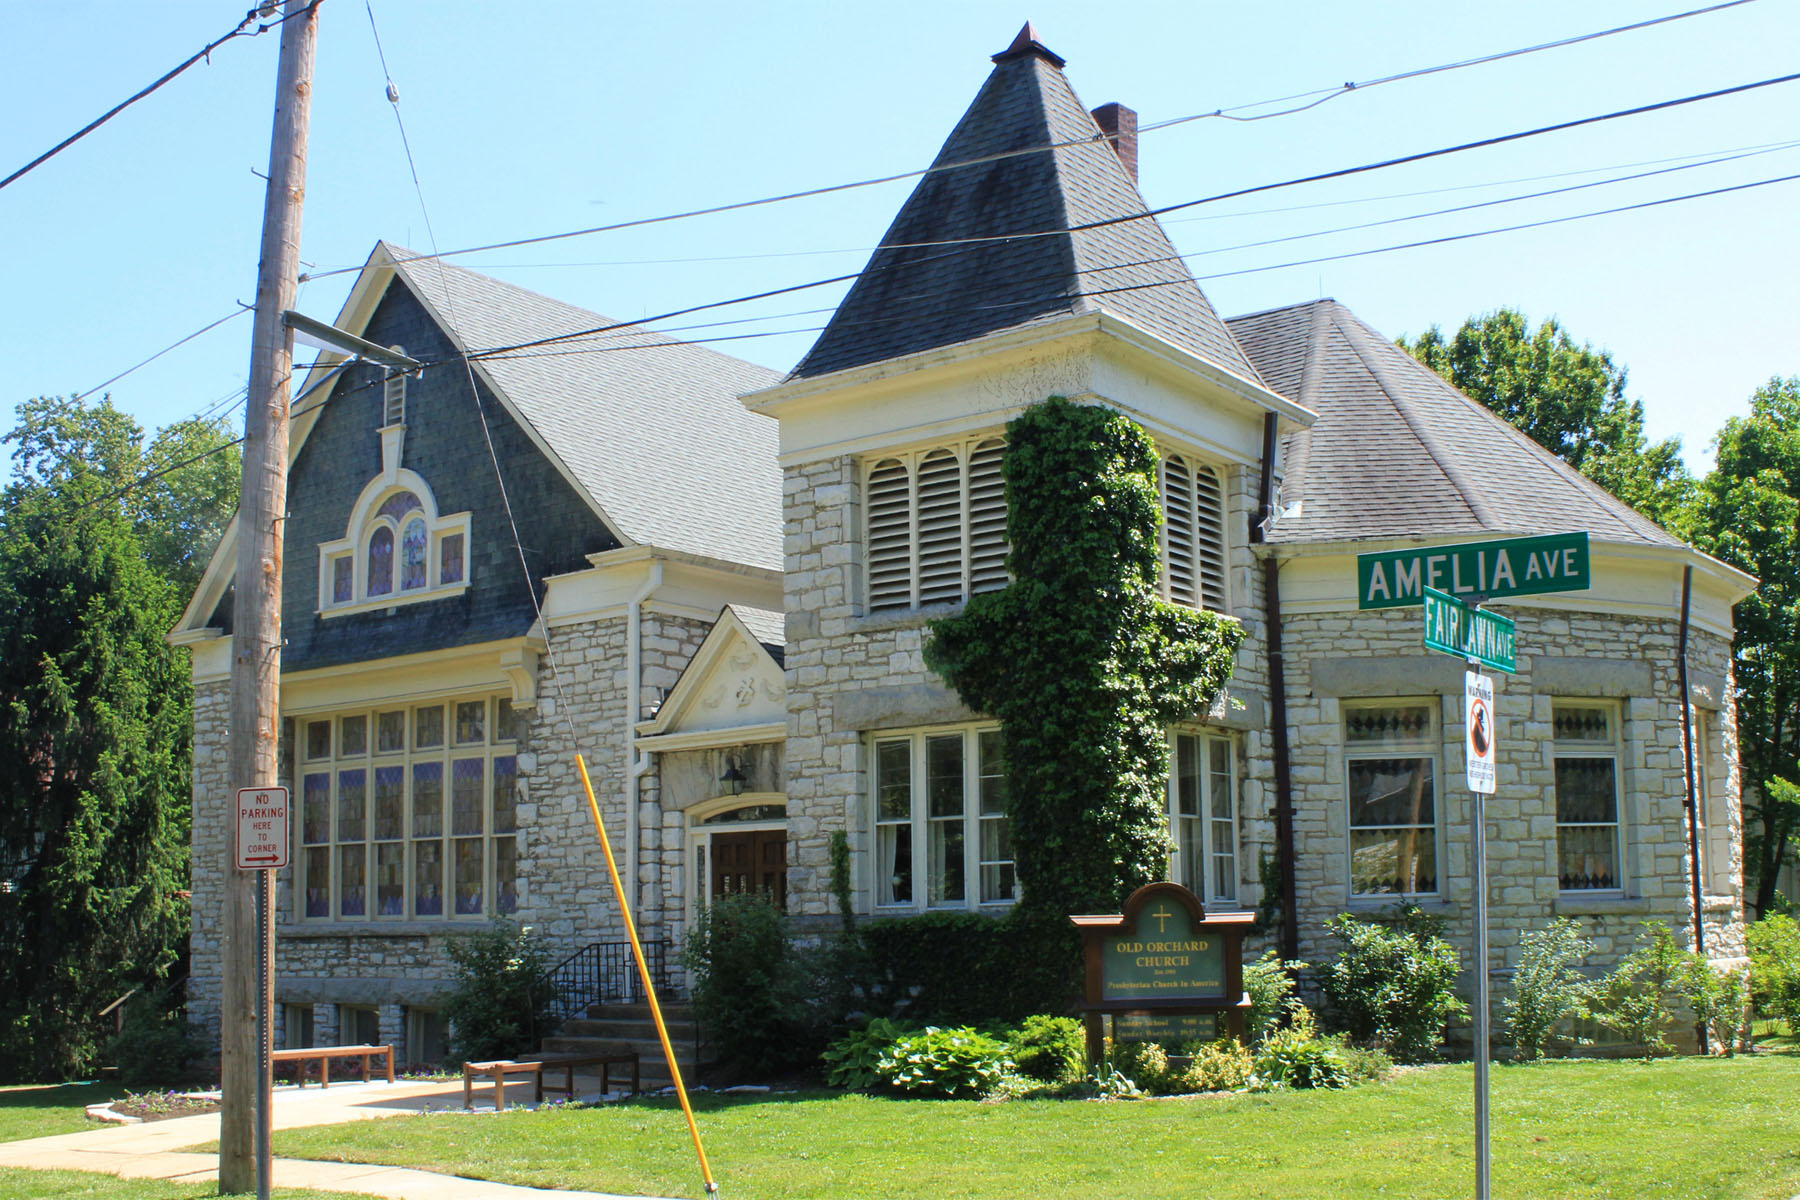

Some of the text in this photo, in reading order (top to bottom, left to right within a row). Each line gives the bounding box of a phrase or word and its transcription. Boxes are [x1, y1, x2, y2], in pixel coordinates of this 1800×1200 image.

[1367, 548, 1579, 601] AMELIA AVE
[1425, 596, 1514, 660] FAIRLAWN AVE
[256, 794, 269, 805] NO
[241, 808, 284, 819] PARKING
[253, 821, 272, 830] HERE
[258, 833, 267, 841] TO
[248, 844, 277, 853] CORNER
[1116, 941, 1209, 953] OLD ORCHARD
[1136, 956, 1190, 967] CHURCH
